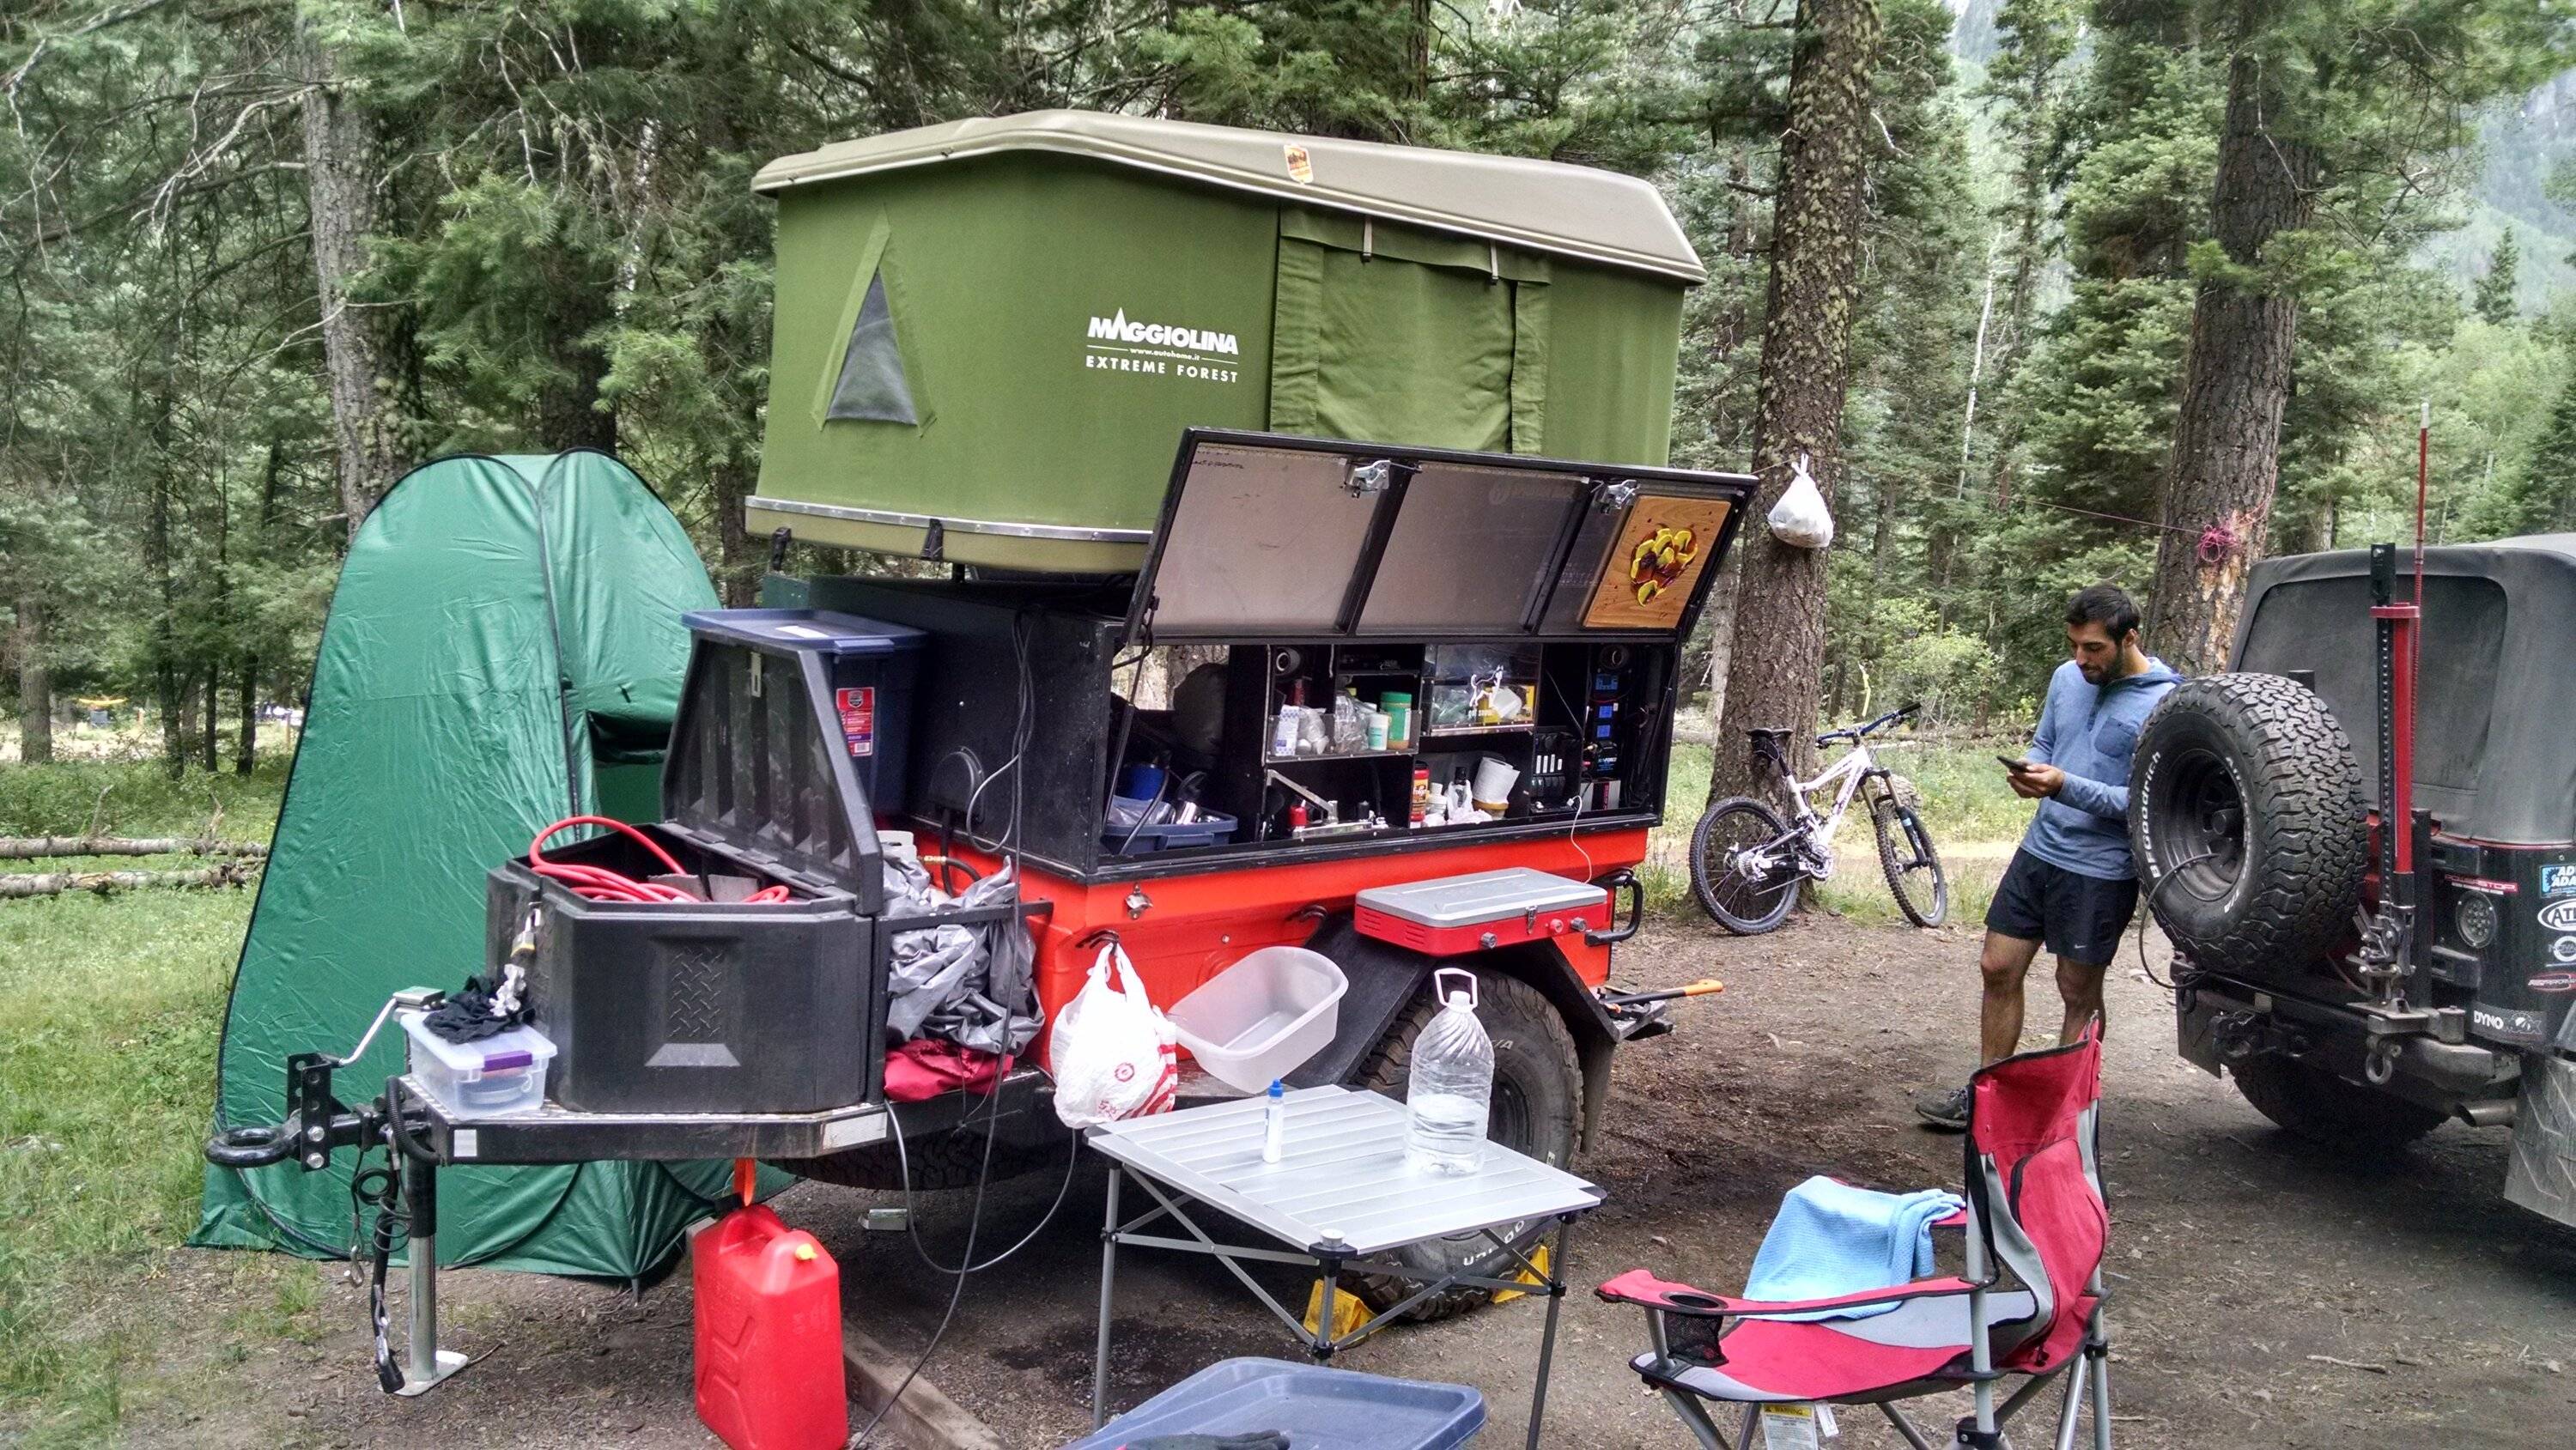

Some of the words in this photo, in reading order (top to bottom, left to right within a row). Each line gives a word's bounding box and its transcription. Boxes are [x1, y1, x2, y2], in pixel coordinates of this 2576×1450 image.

[1087, 306, 1239, 355] MAGGIOLINA
[1129, 348, 1200, 361] www.autohome.it
[1086, 355, 1166, 374] EXTREME
[1176, 364, 1238, 383] FOREST
[2557, 865, 2576, 877] AD
